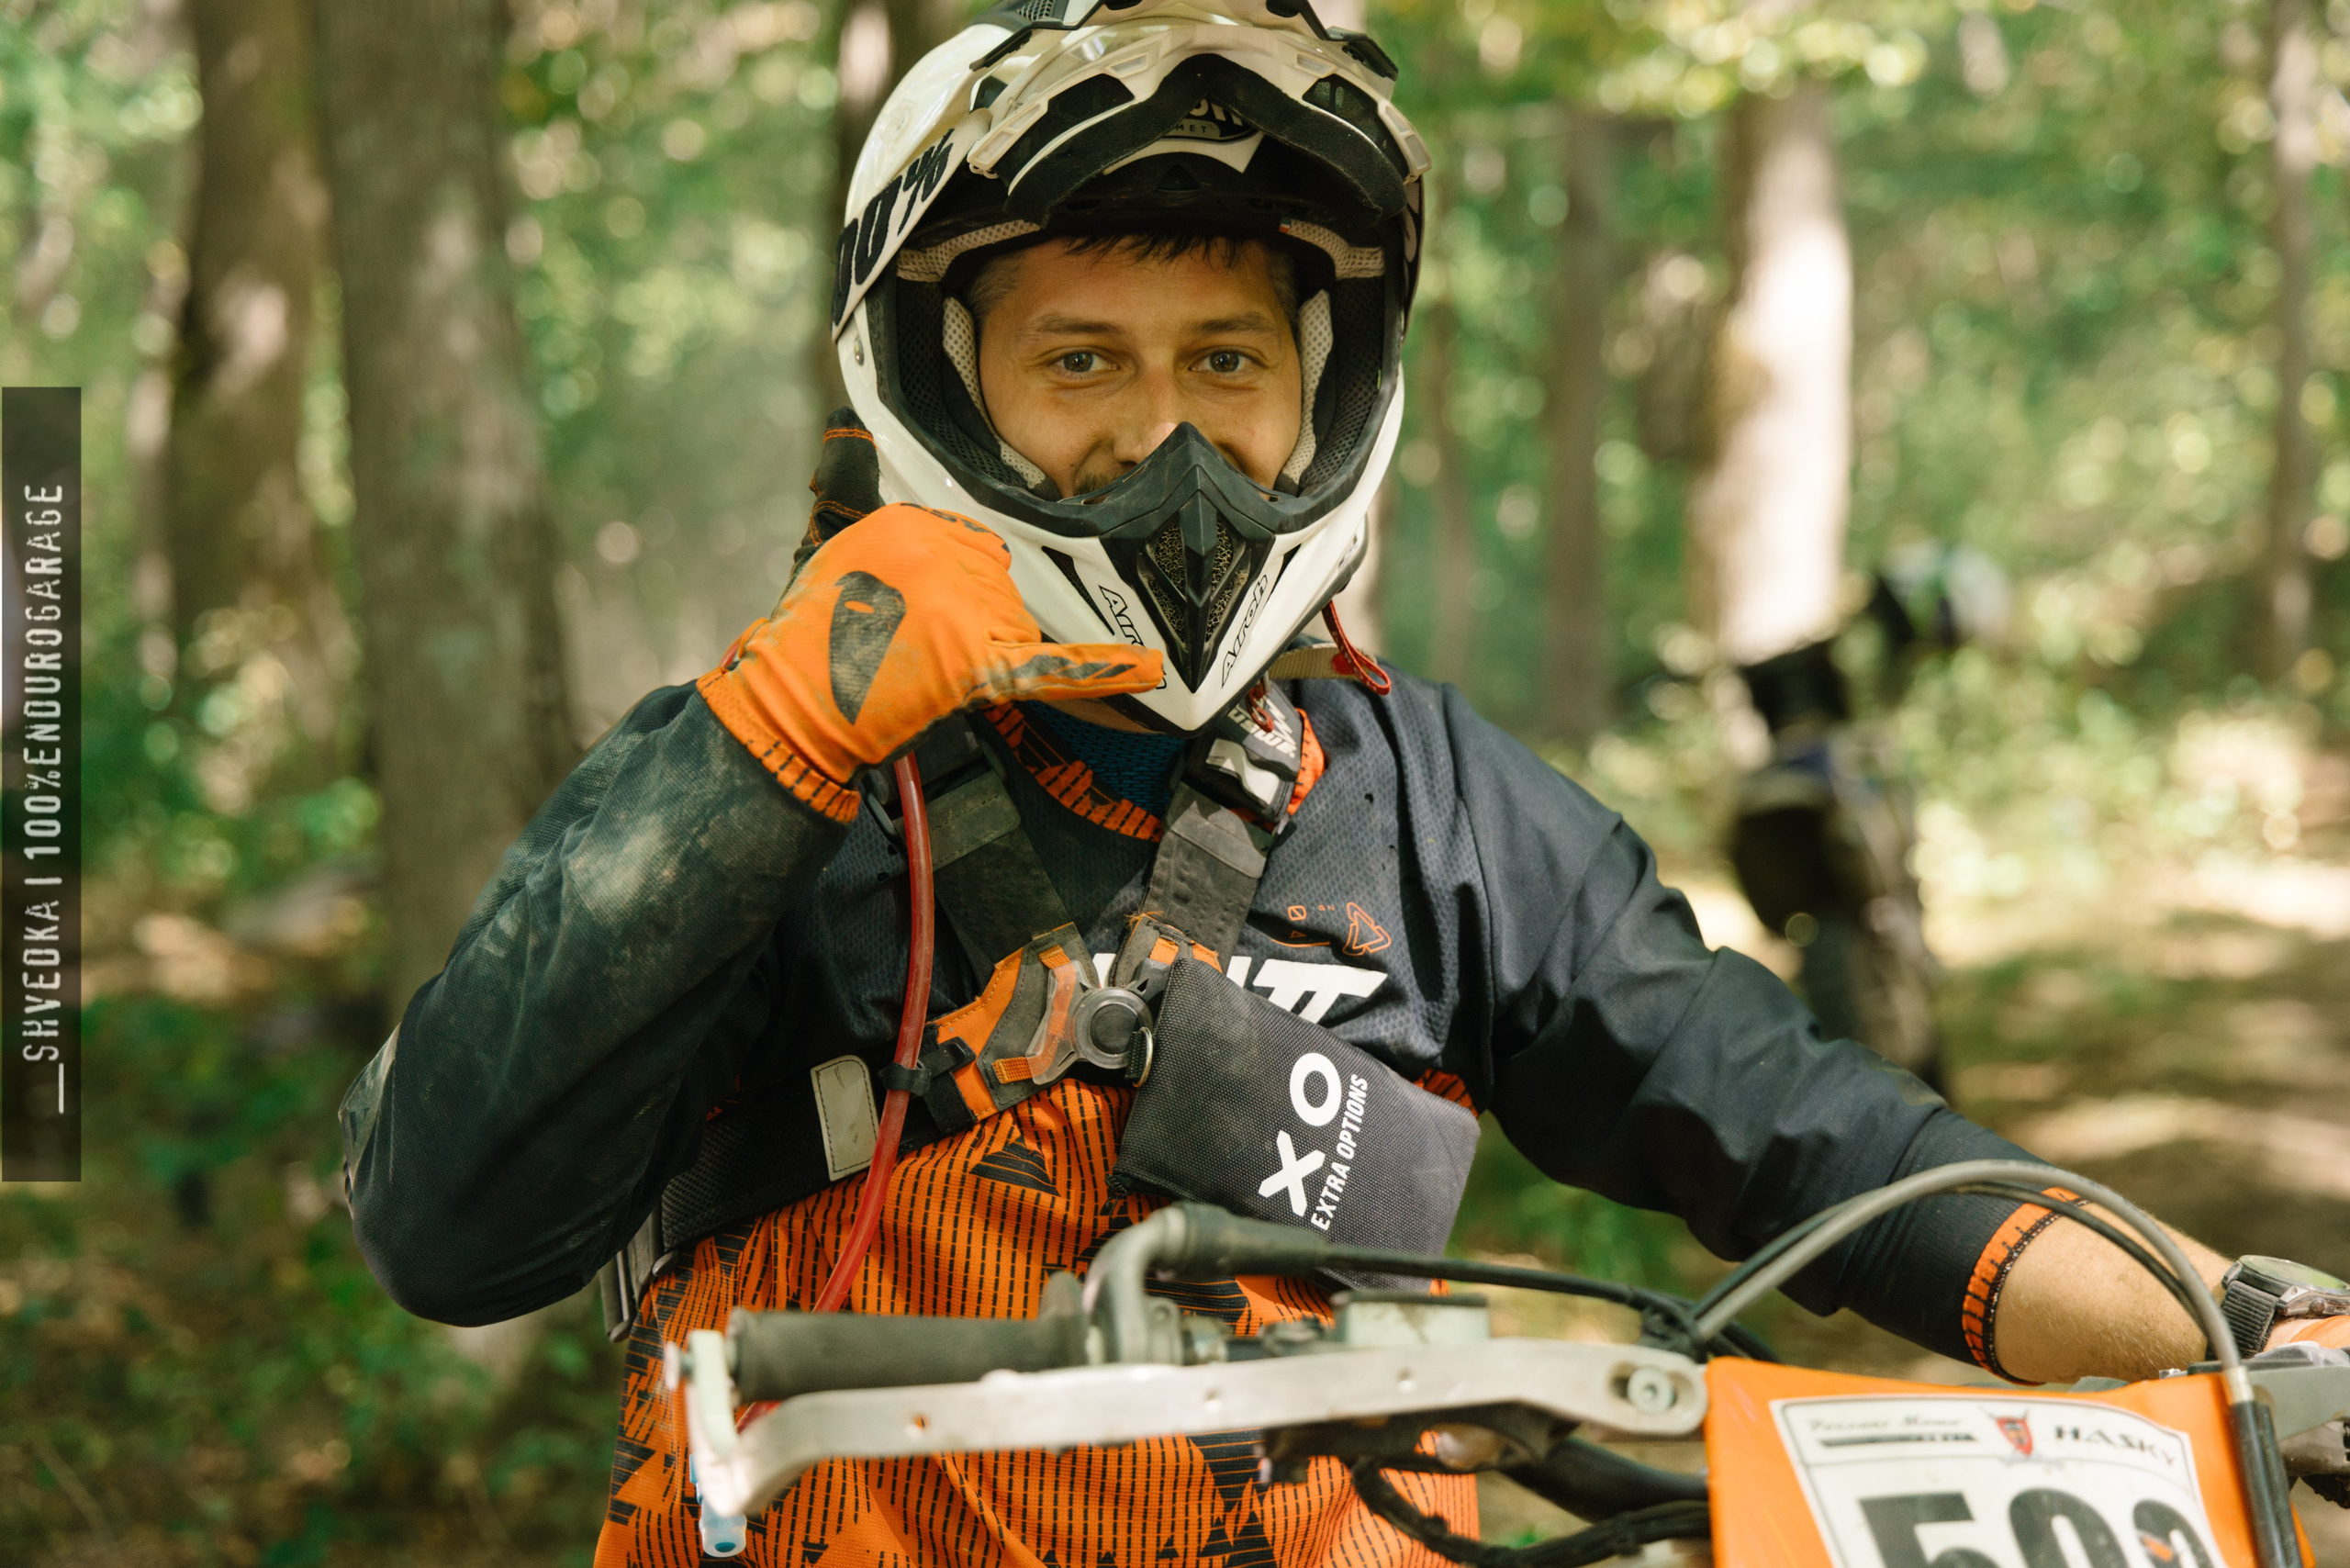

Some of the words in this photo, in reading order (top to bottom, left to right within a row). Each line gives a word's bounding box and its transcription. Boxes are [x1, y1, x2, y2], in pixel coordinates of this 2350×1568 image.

[832, 128, 956, 327] 00%
[1098, 584, 1168, 689] Air
[1311, 1161, 1350, 1230] EXTRA
[1337, 1074, 1368, 1159] OPTIONS
[2053, 1425, 2176, 1466] HASKY
